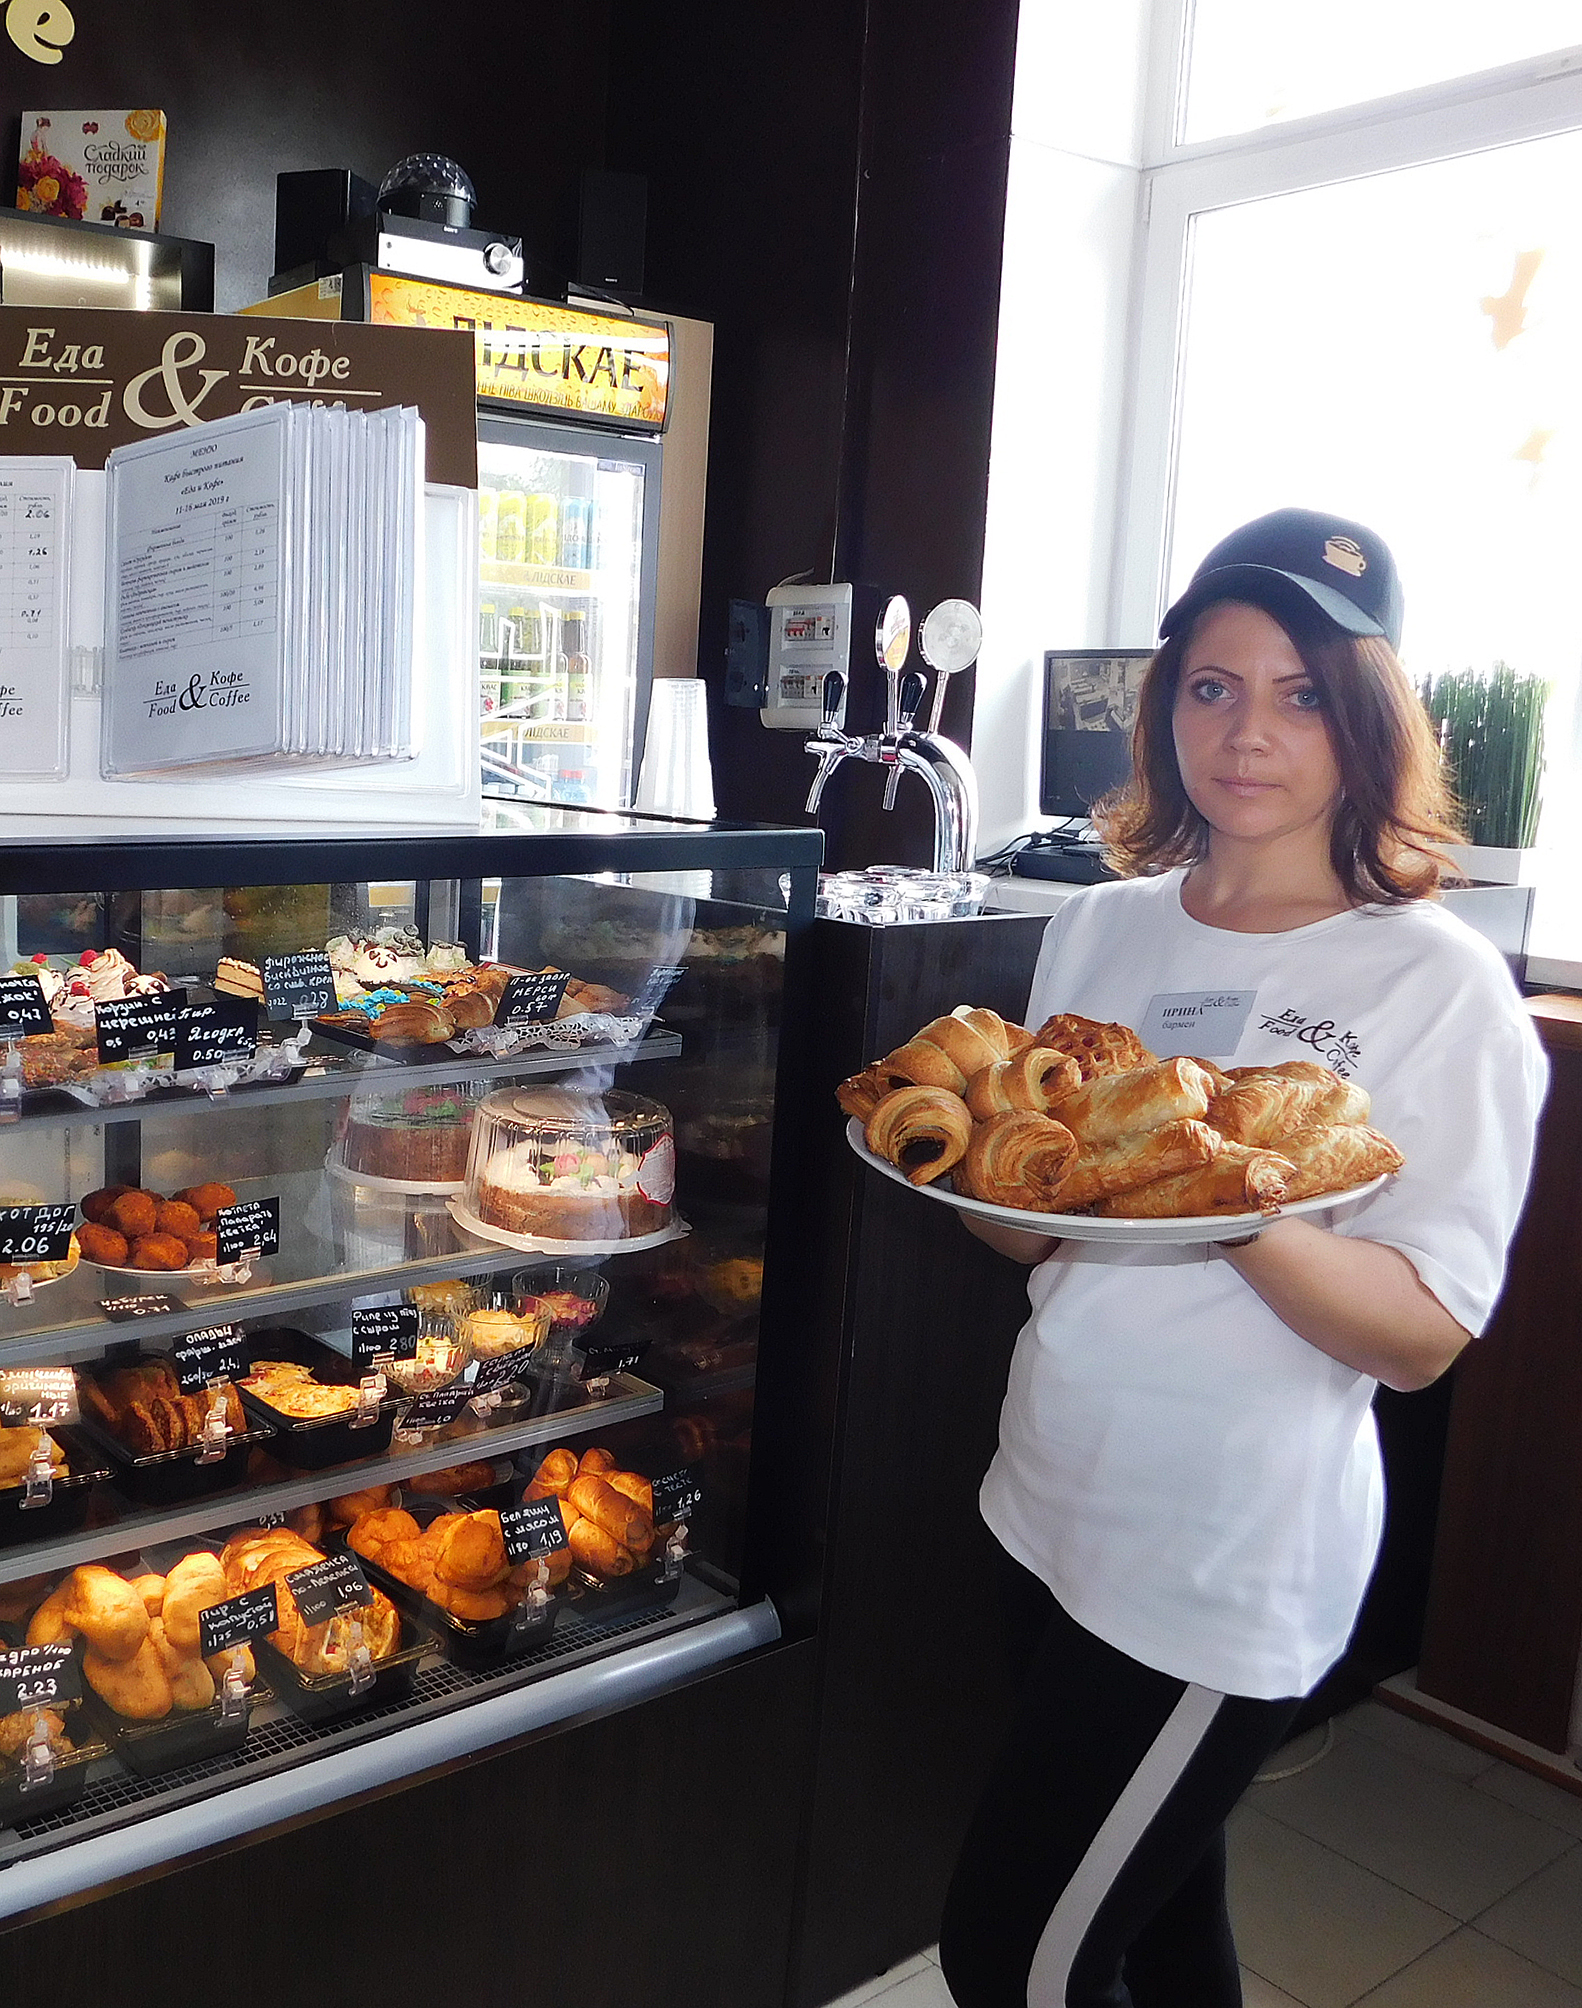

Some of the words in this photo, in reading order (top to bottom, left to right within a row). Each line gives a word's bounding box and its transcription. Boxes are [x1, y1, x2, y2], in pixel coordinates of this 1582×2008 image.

[84, 140, 147, 162] Сладкий
[85, 162, 149, 185] подарок
[19, 328, 104, 374] Еда
[239, 335, 350, 386] Кофе
[123, 331, 230, 429] &
[0, 387, 112, 427] Food
[208, 496, 225, 507] 2019
[25, 509, 50, 518] 2.06
[210, 669, 244, 686] Кофе
[154, 680, 177, 696] Еда
[178, 673, 208, 711] &
[209, 689, 250, 708] Coffee
[148, 698, 177, 718] Food
[511, 1001, 548, 1014] 0.57
[1162, 1006, 1203, 1017] ИРИНА
[1162, 1020, 1196, 1030] бармен
[1258, 1020, 1297, 1037] Food
[1297, 1020, 1336, 1052] &
[193, 1048, 223, 1060] 0.50
[2, 1237, 49, 1254] 2.06
[254, 1229, 277, 1246] 2,64
[30, 1402, 70, 1418] 1.17
[677, 1489, 702, 1508] 1,26
[515, 1514, 560, 1534] мясом
[540, 1529, 563, 1547] 1,19
[337, 1581, 363, 1599] 1,06
[17, 1678, 57, 1698] 2.23
